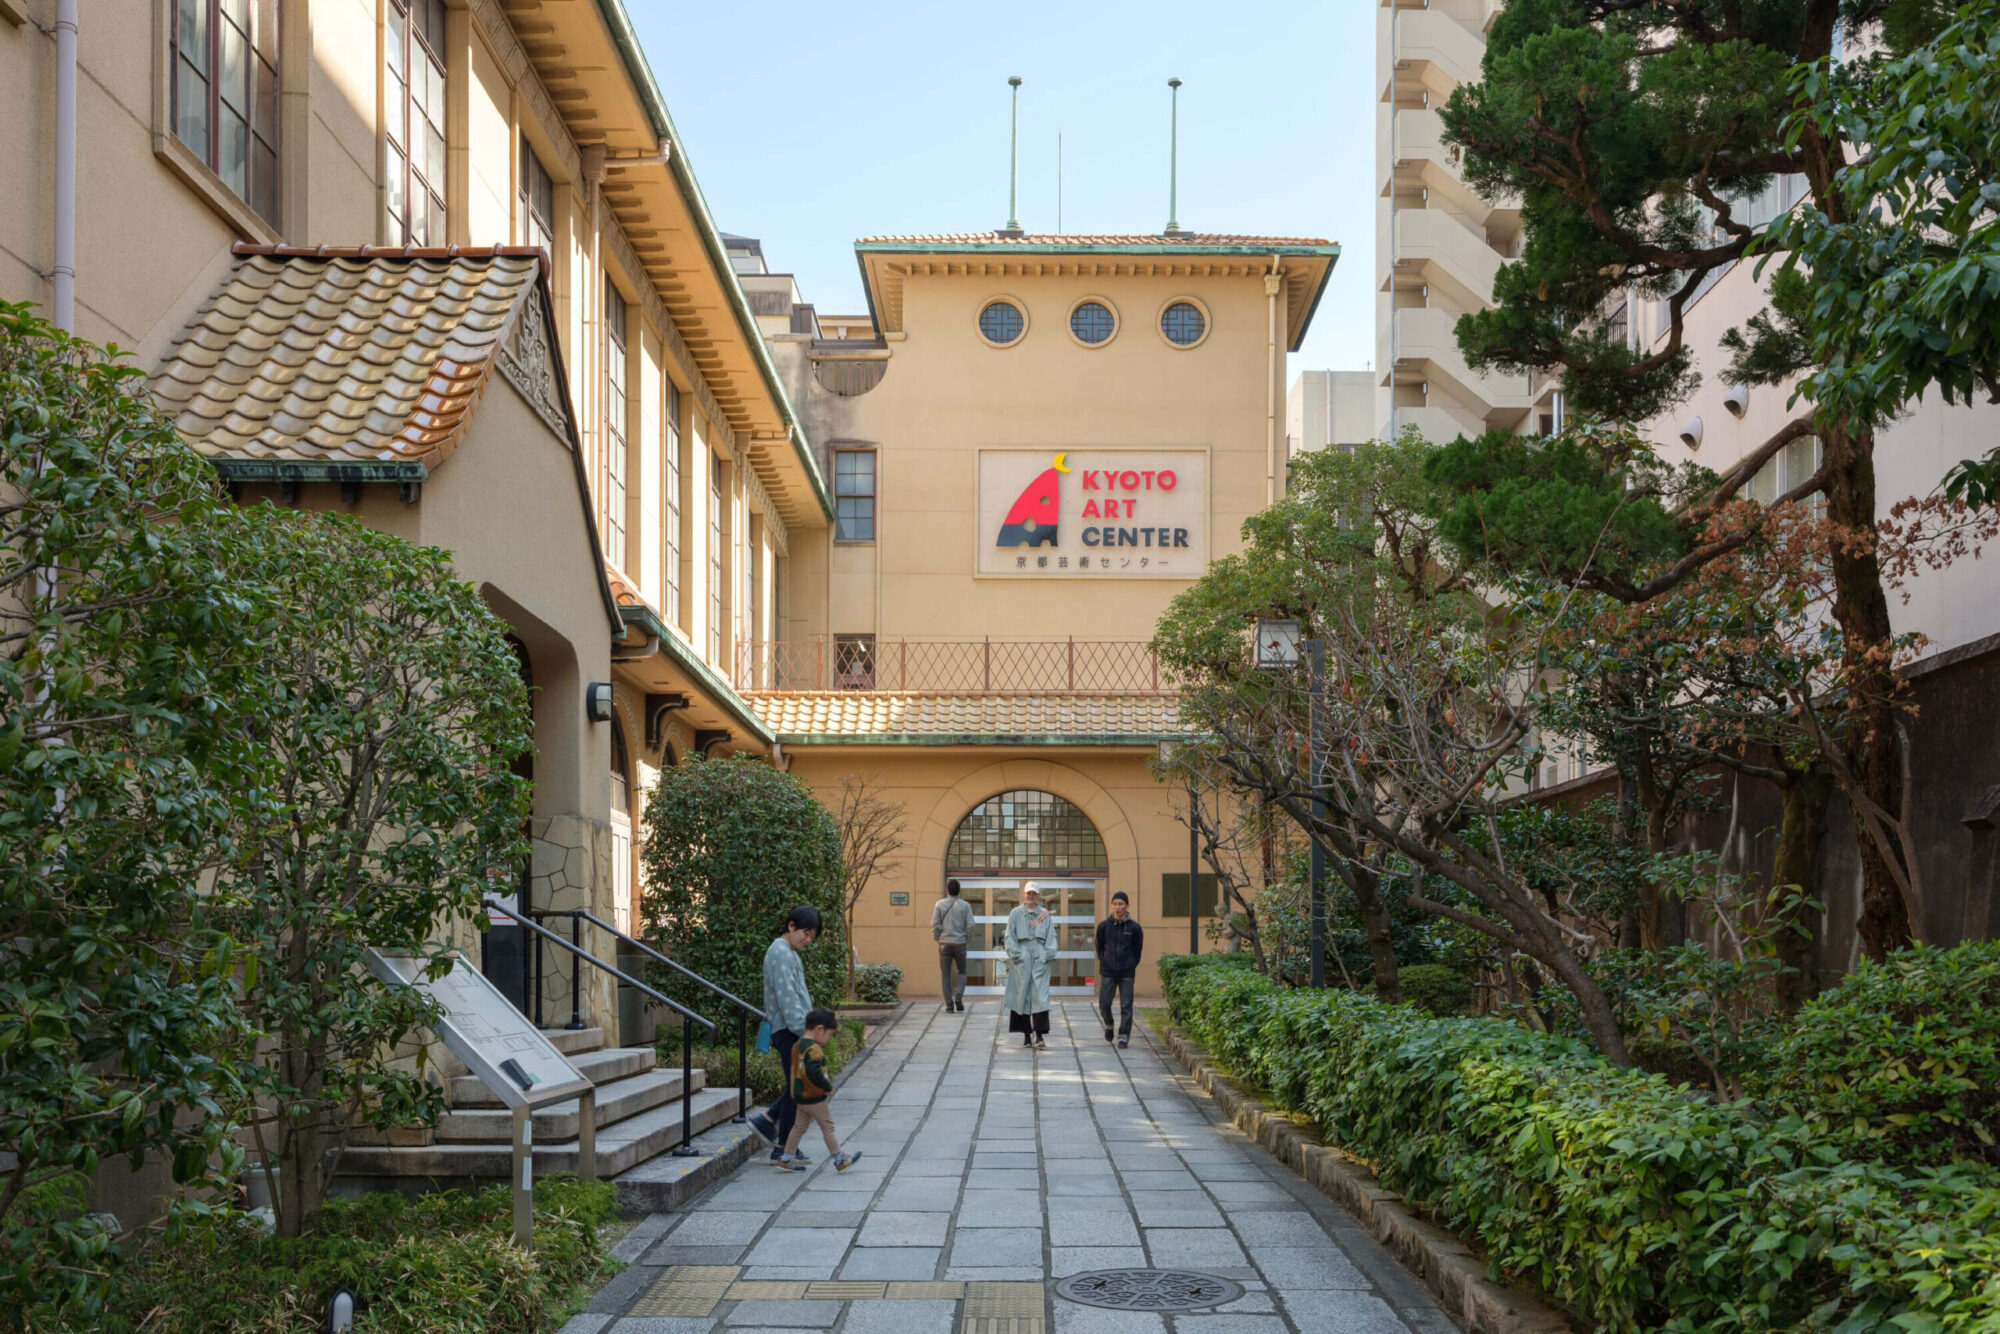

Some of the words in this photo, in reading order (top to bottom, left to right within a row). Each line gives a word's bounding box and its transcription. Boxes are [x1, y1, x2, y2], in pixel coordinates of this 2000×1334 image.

[1082, 470, 1177, 491] KYOTO
[1081, 498, 1137, 518] ART
[1081, 527, 1189, 548] CENTER
[1015, 556, 1169, 568] 京都芸術センター
